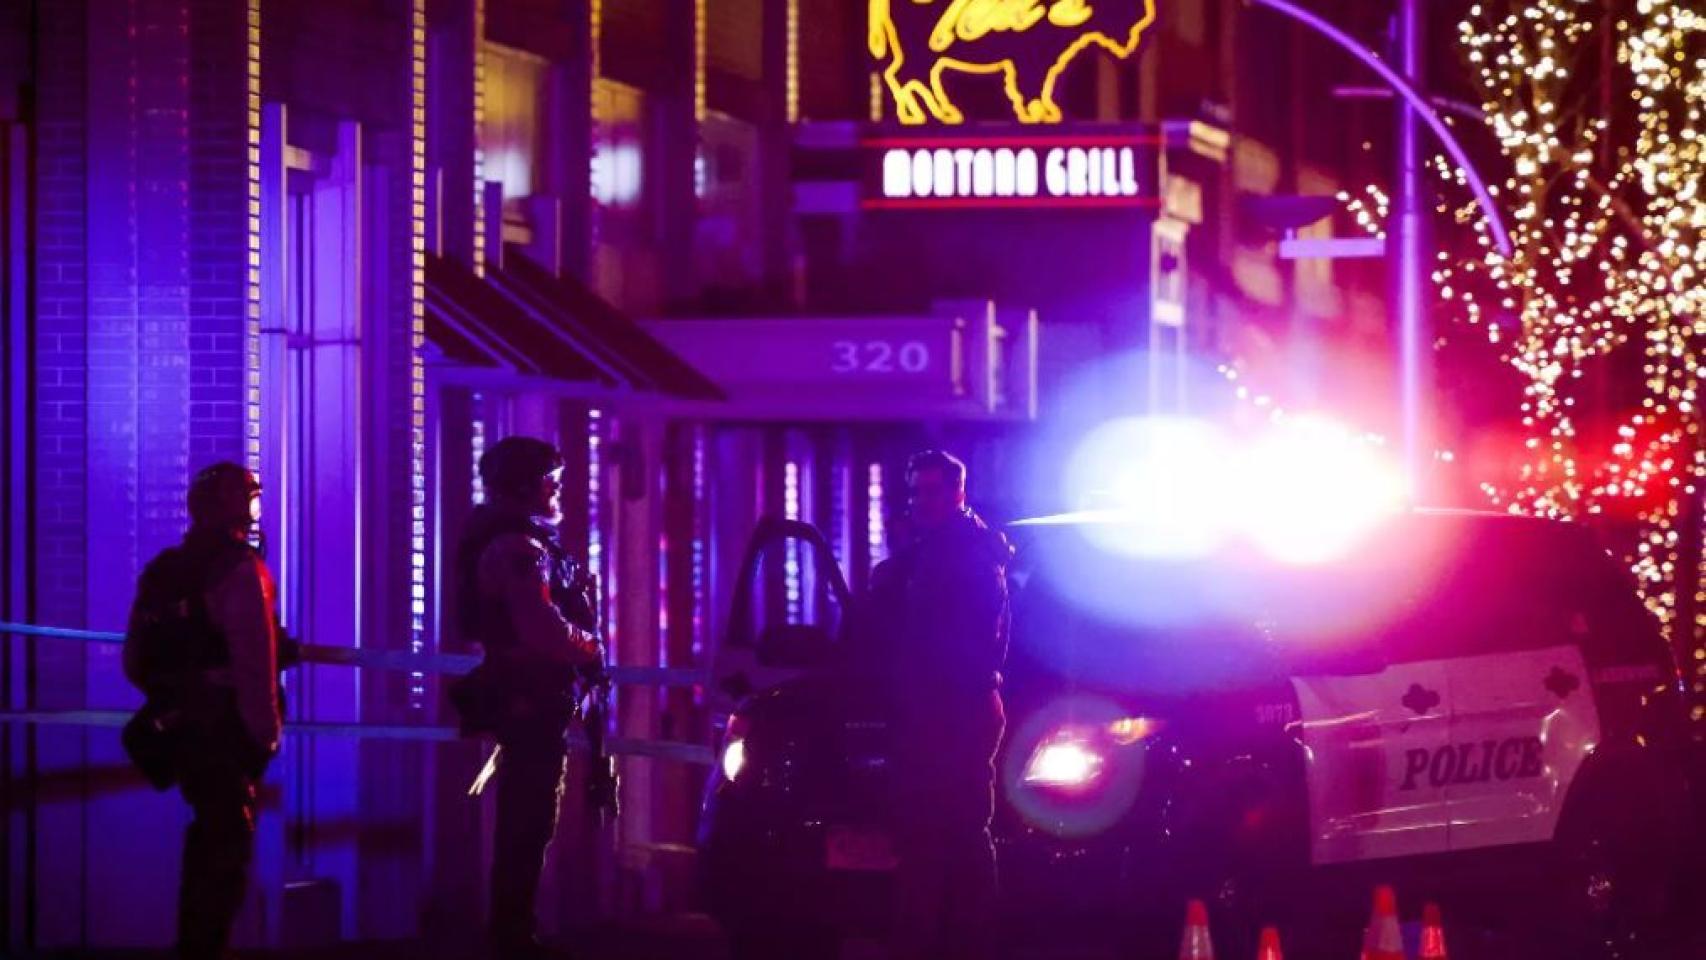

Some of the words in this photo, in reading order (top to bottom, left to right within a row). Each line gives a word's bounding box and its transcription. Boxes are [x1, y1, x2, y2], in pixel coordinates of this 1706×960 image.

[883, 148, 1038, 196] MONTANA
[1045, 147, 1138, 196] GRILL
[831, 340, 929, 373] 320
[1400, 736, 1543, 790] POLICE
